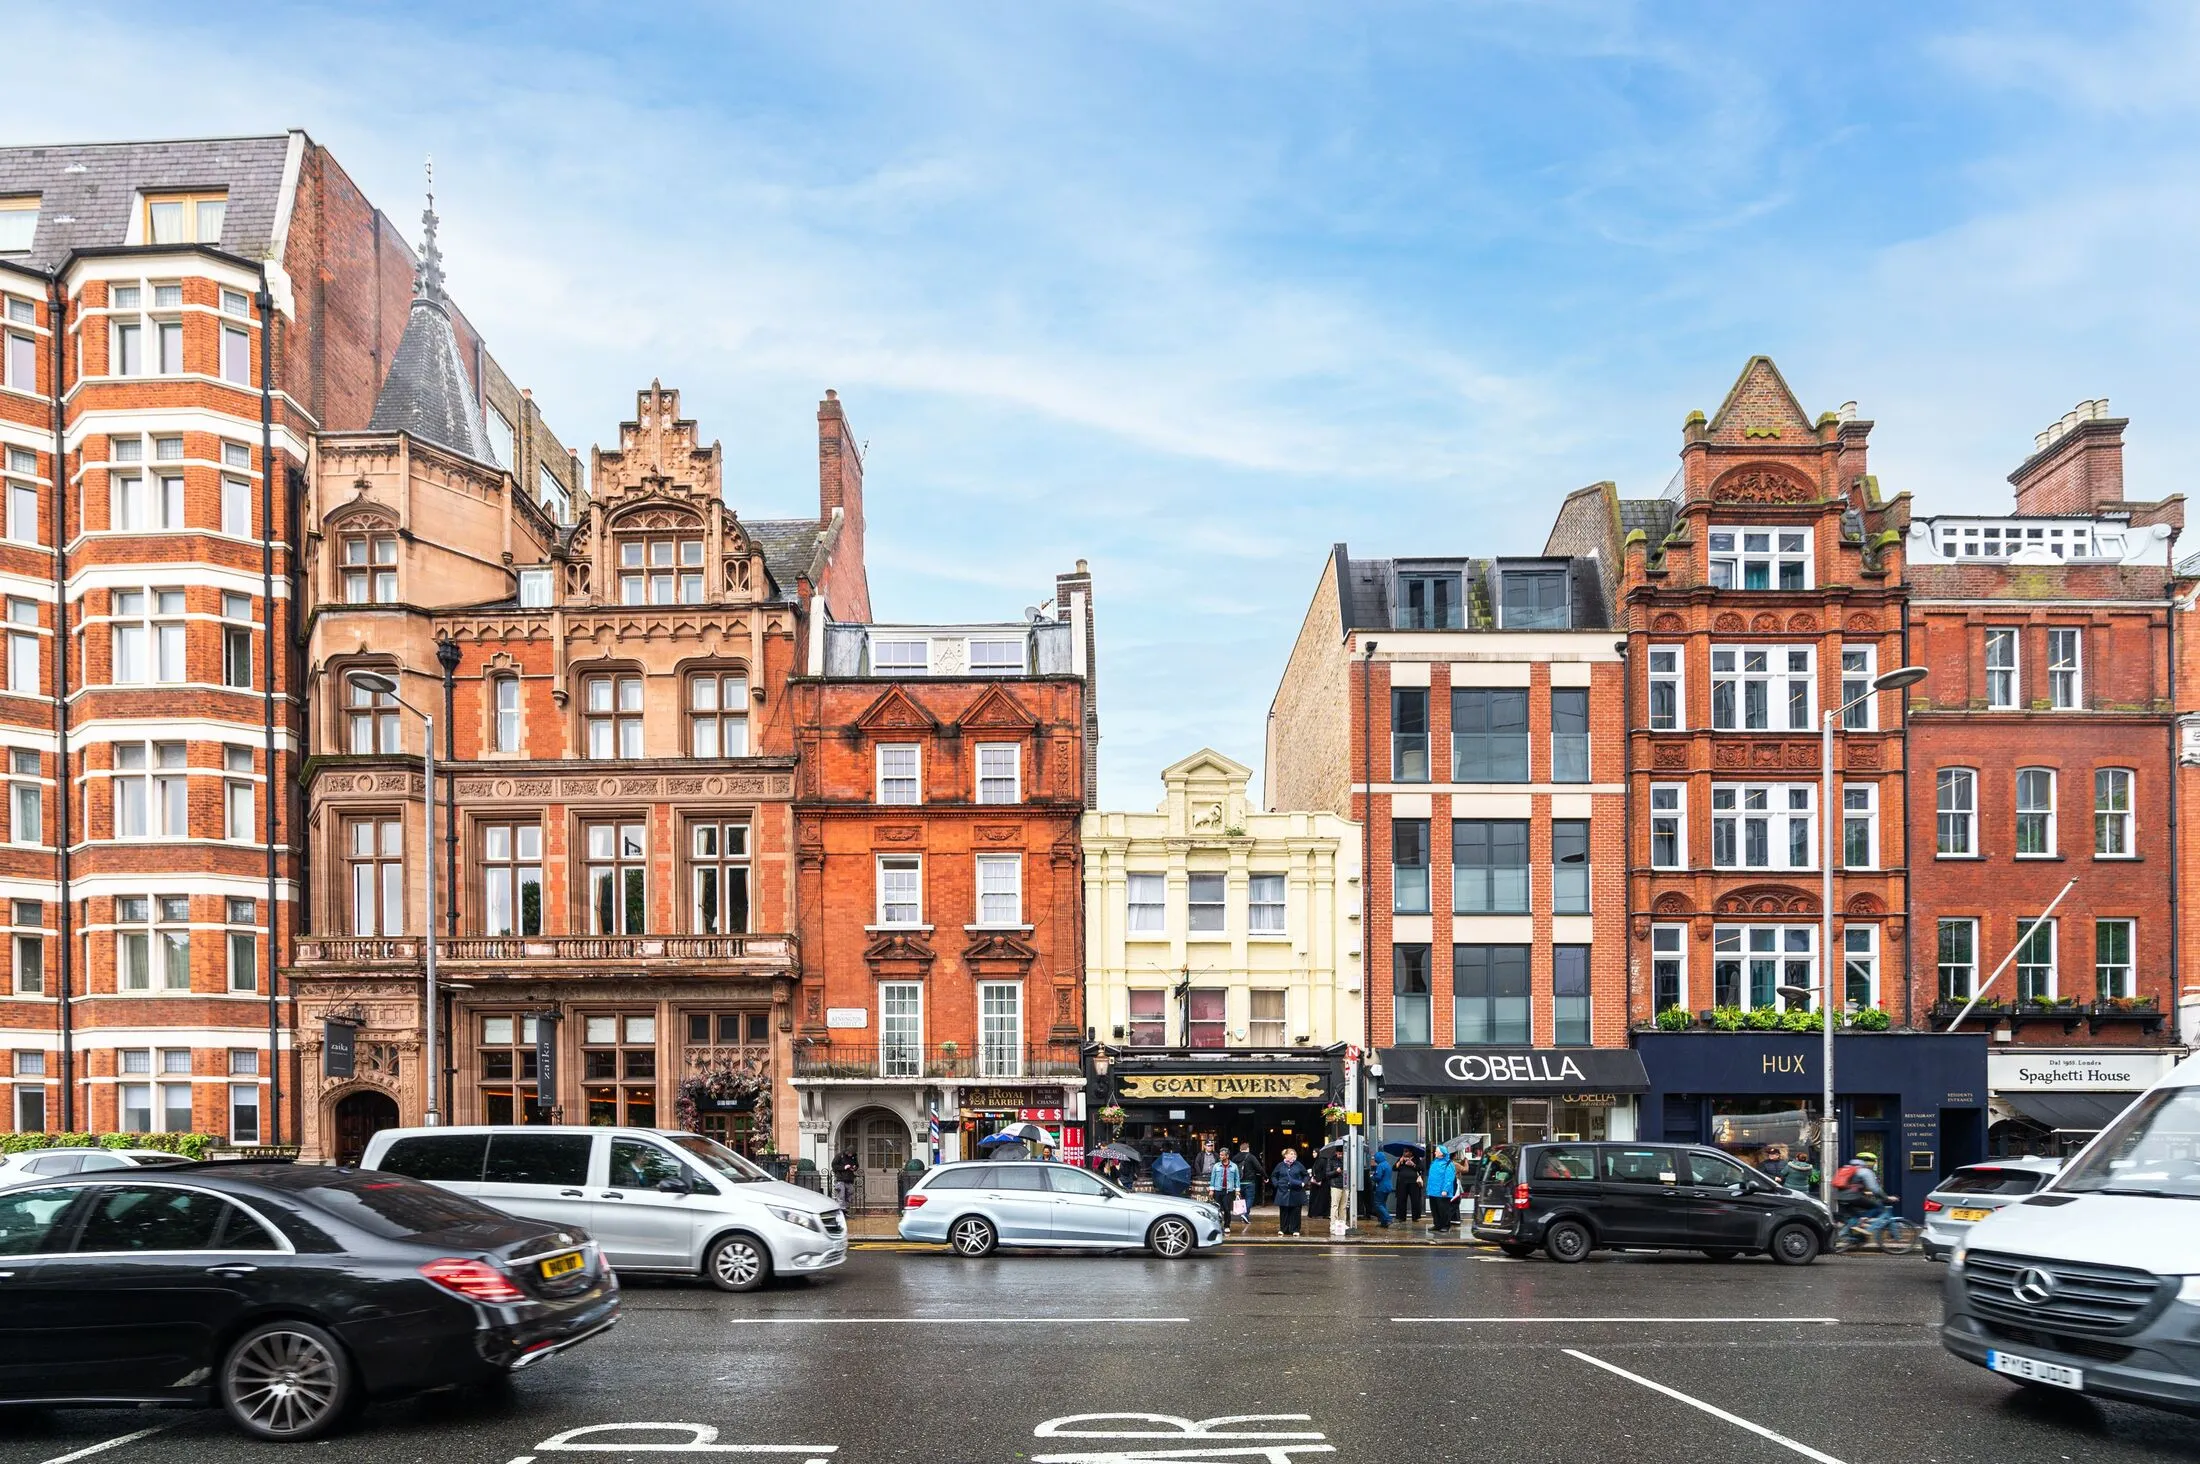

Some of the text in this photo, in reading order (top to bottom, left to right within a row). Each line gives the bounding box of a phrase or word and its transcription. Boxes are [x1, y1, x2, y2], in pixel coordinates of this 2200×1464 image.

[1348, 1049, 1359, 1057] N
[542, 1042, 550, 1080] zaika
[1445, 1055, 1586, 1081] COBELLA
[1763, 1054, 1805, 1074] HUX
[2019, 1068, 2131, 1084] Spaghetti House
[960, 1088, 965, 1096] 3
[1153, 1078, 1293, 1092] GOAT TAVERN
[993, 1088, 1025, 1098] ROYAL
